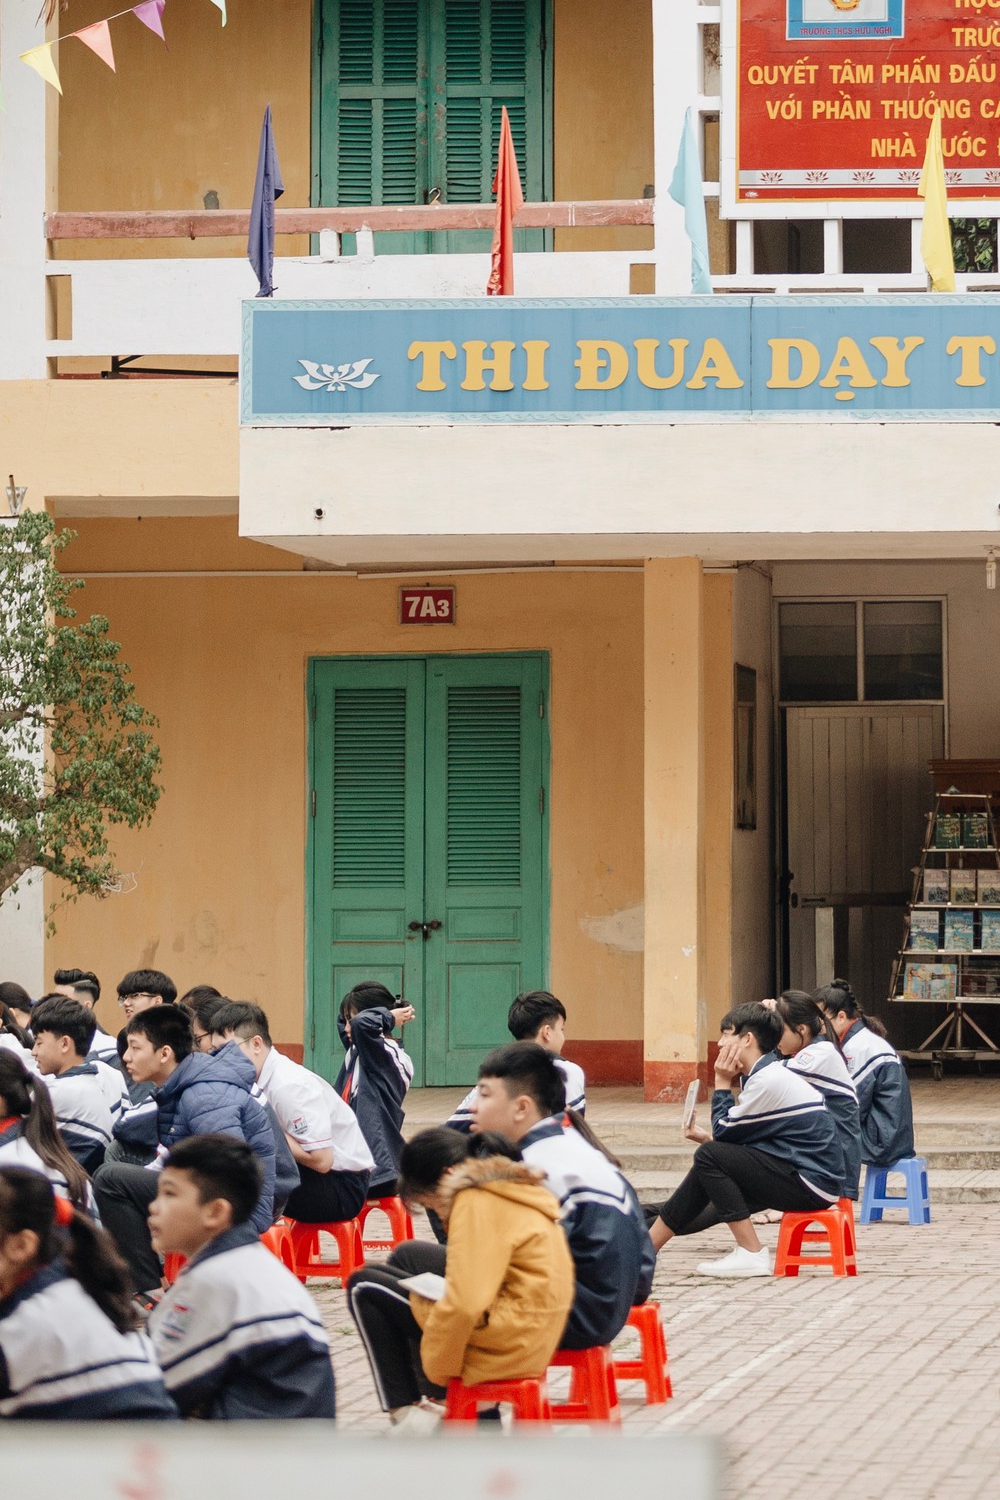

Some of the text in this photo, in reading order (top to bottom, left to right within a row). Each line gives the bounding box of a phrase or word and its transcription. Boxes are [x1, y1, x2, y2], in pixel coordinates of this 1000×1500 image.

[748, 56, 818, 84] QUYẾT
[829, 59, 874, 84] TÂM
[882, 56, 940, 84] PHẤN
[949, 55, 996, 84] ĐẤU
[766, 93, 802, 120] VỚI
[812, 90, 870, 120] PHẦN
[881, 91, 970, 119] THƯỞNG
[871, 132, 916, 157] NHÀ
[926, 131, 986, 157] ƯỚC
[407, 340, 550, 391] THI
[574, 337, 744, 390] ĐUA
[767, 335, 925, 401] DẠY
[405, 596, 449, 617] 7A3
